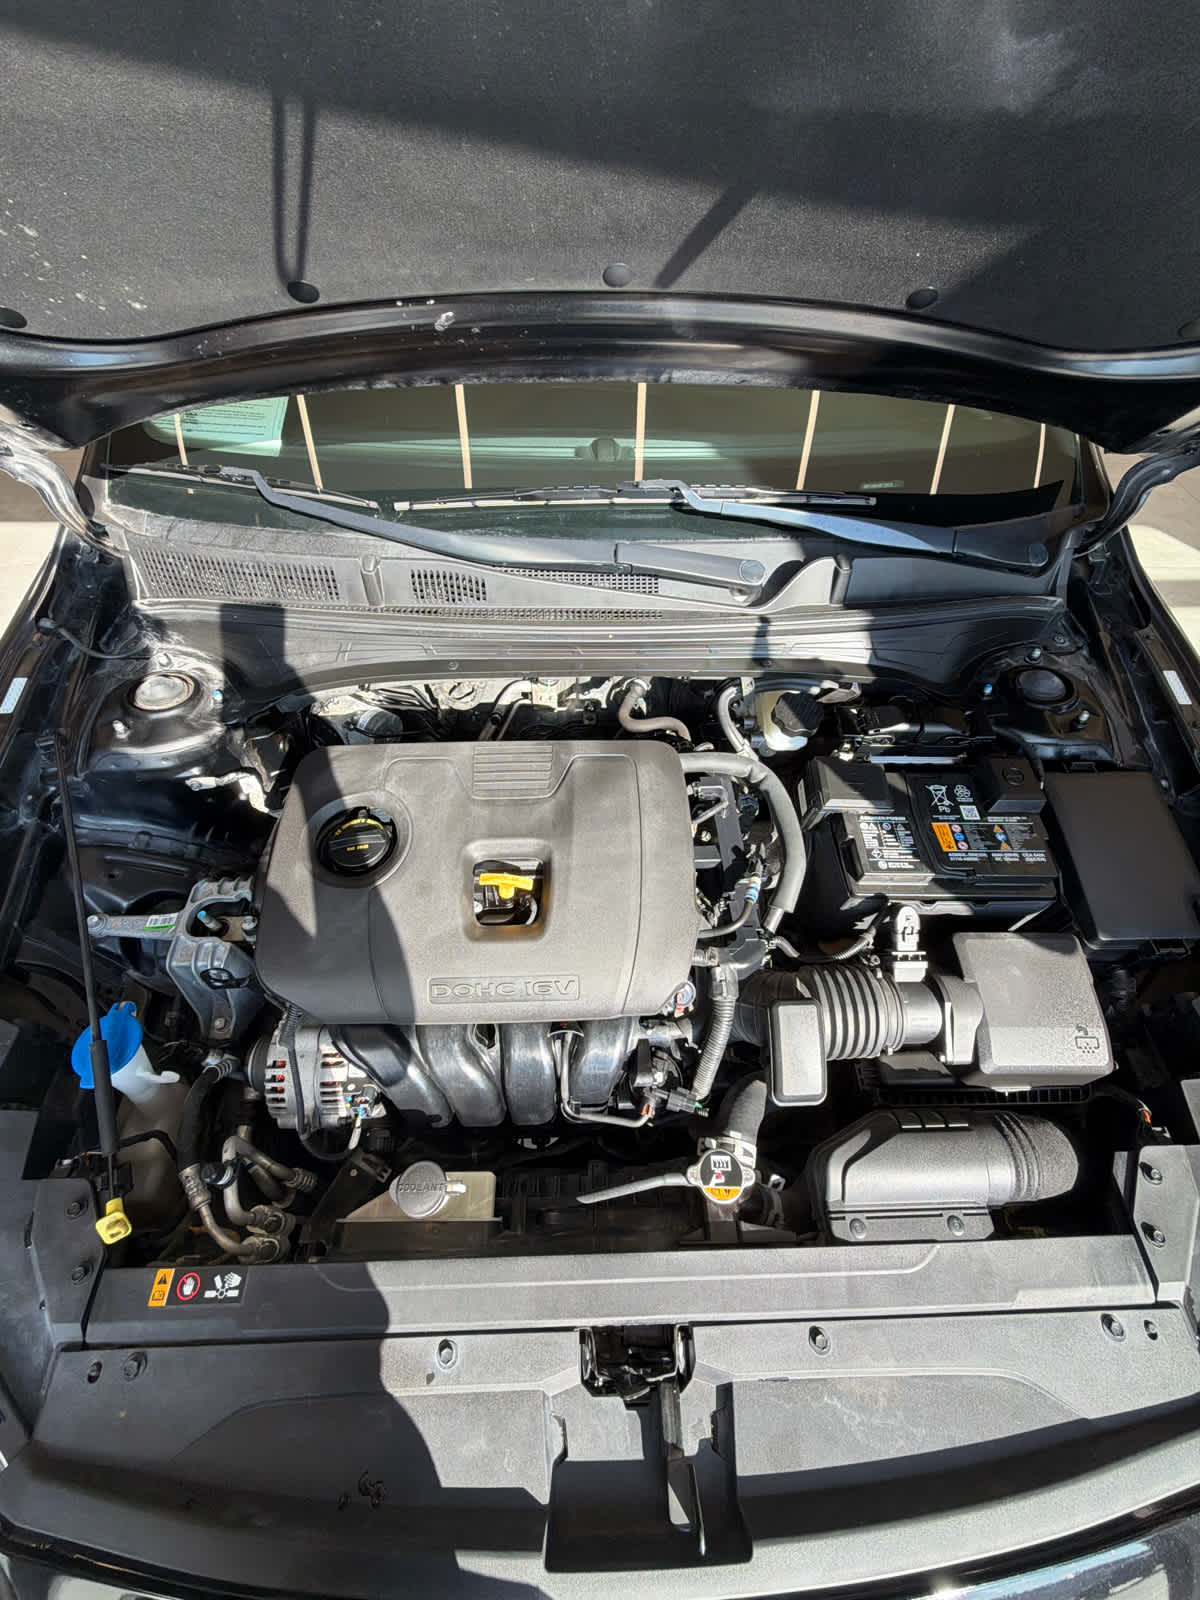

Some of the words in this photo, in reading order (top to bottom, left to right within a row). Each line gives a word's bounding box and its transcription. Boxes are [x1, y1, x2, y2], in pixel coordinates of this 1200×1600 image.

[431, 982, 515, 998] DOHC
[525, 981, 576, 996] 16V
[399, 1183, 445, 1192] COOLANT
